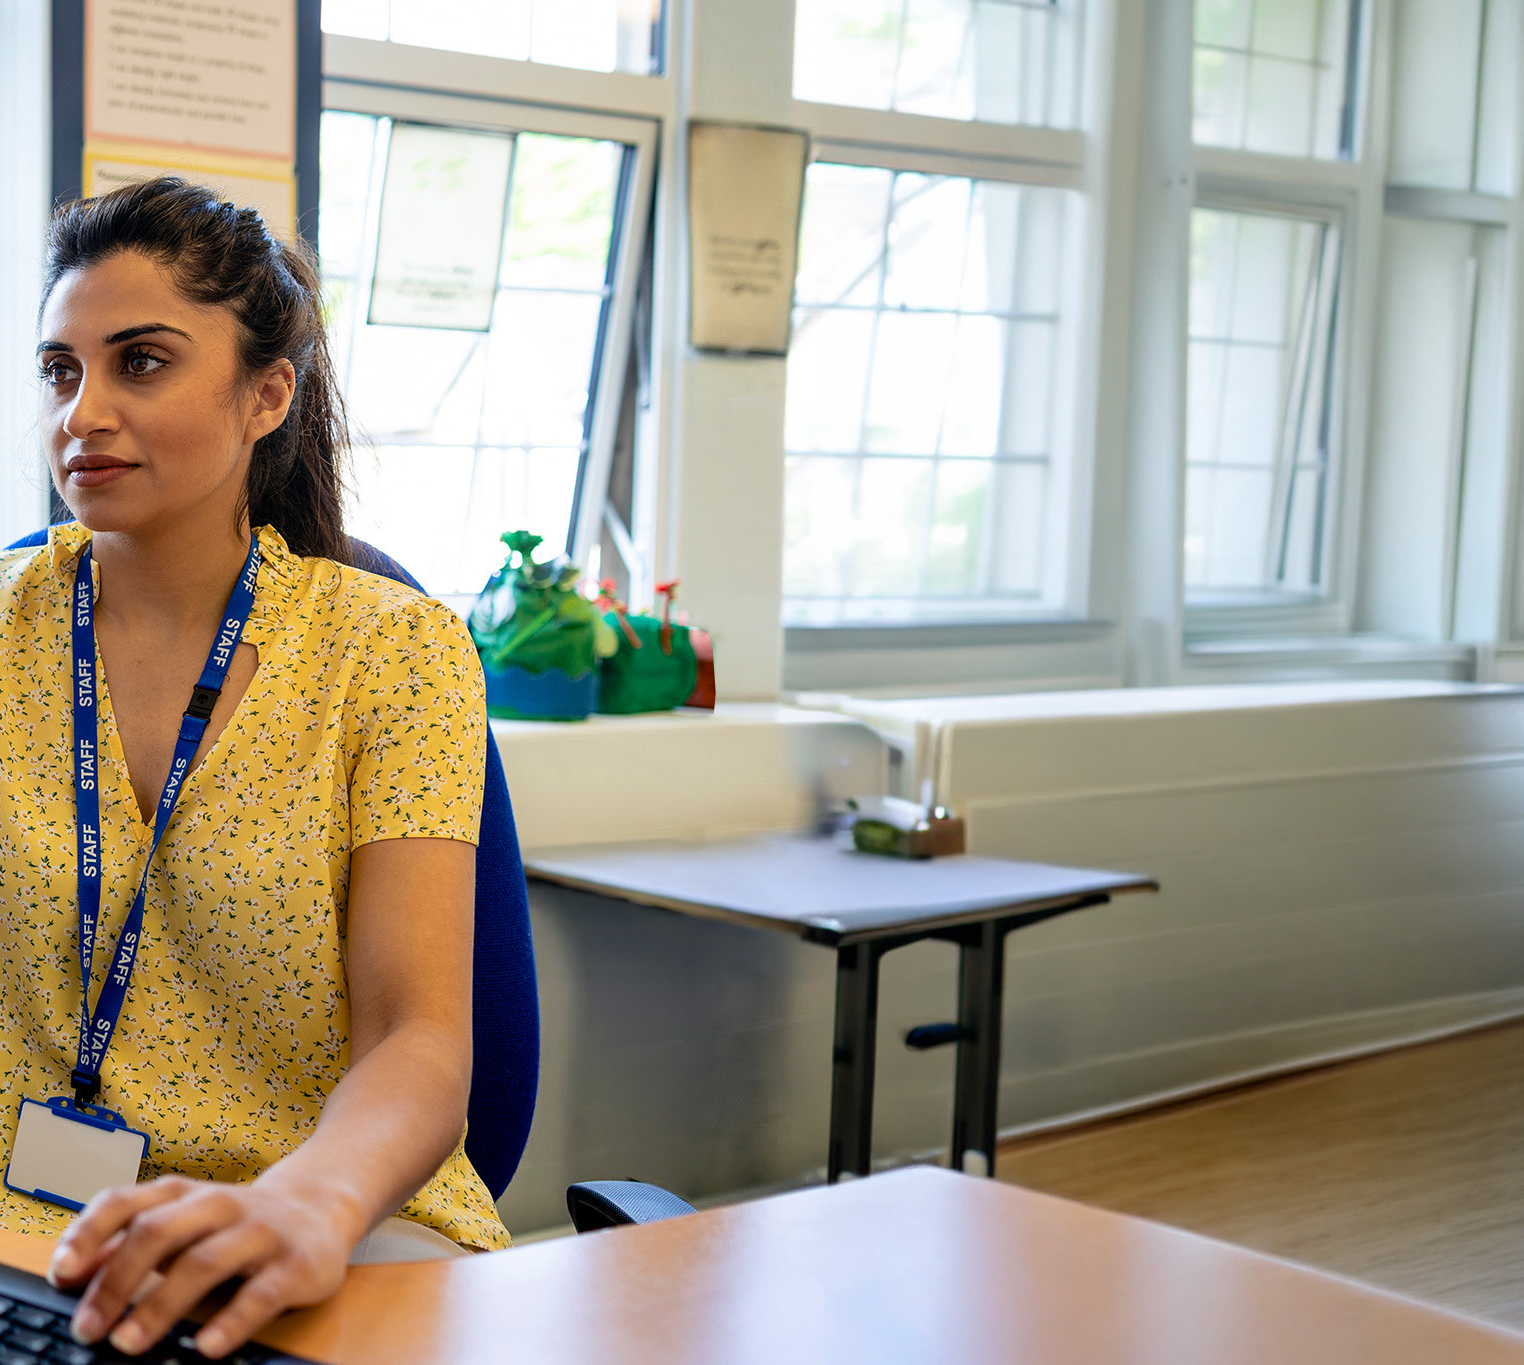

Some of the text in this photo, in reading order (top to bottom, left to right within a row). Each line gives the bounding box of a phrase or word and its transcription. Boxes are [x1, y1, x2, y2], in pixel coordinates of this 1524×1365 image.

[243, 548, 261, 593] STAFF
[77, 582, 89, 627] STAFF
[213, 618, 241, 668] STAFF
[78, 658, 92, 707] STAFF
[80, 739, 94, 791] STAFF
[162, 758, 187, 809] STAFF
[83, 823, 97, 878] STAFF
[83, 914, 94, 968] STAFF
[113, 932, 137, 986] STAFF
